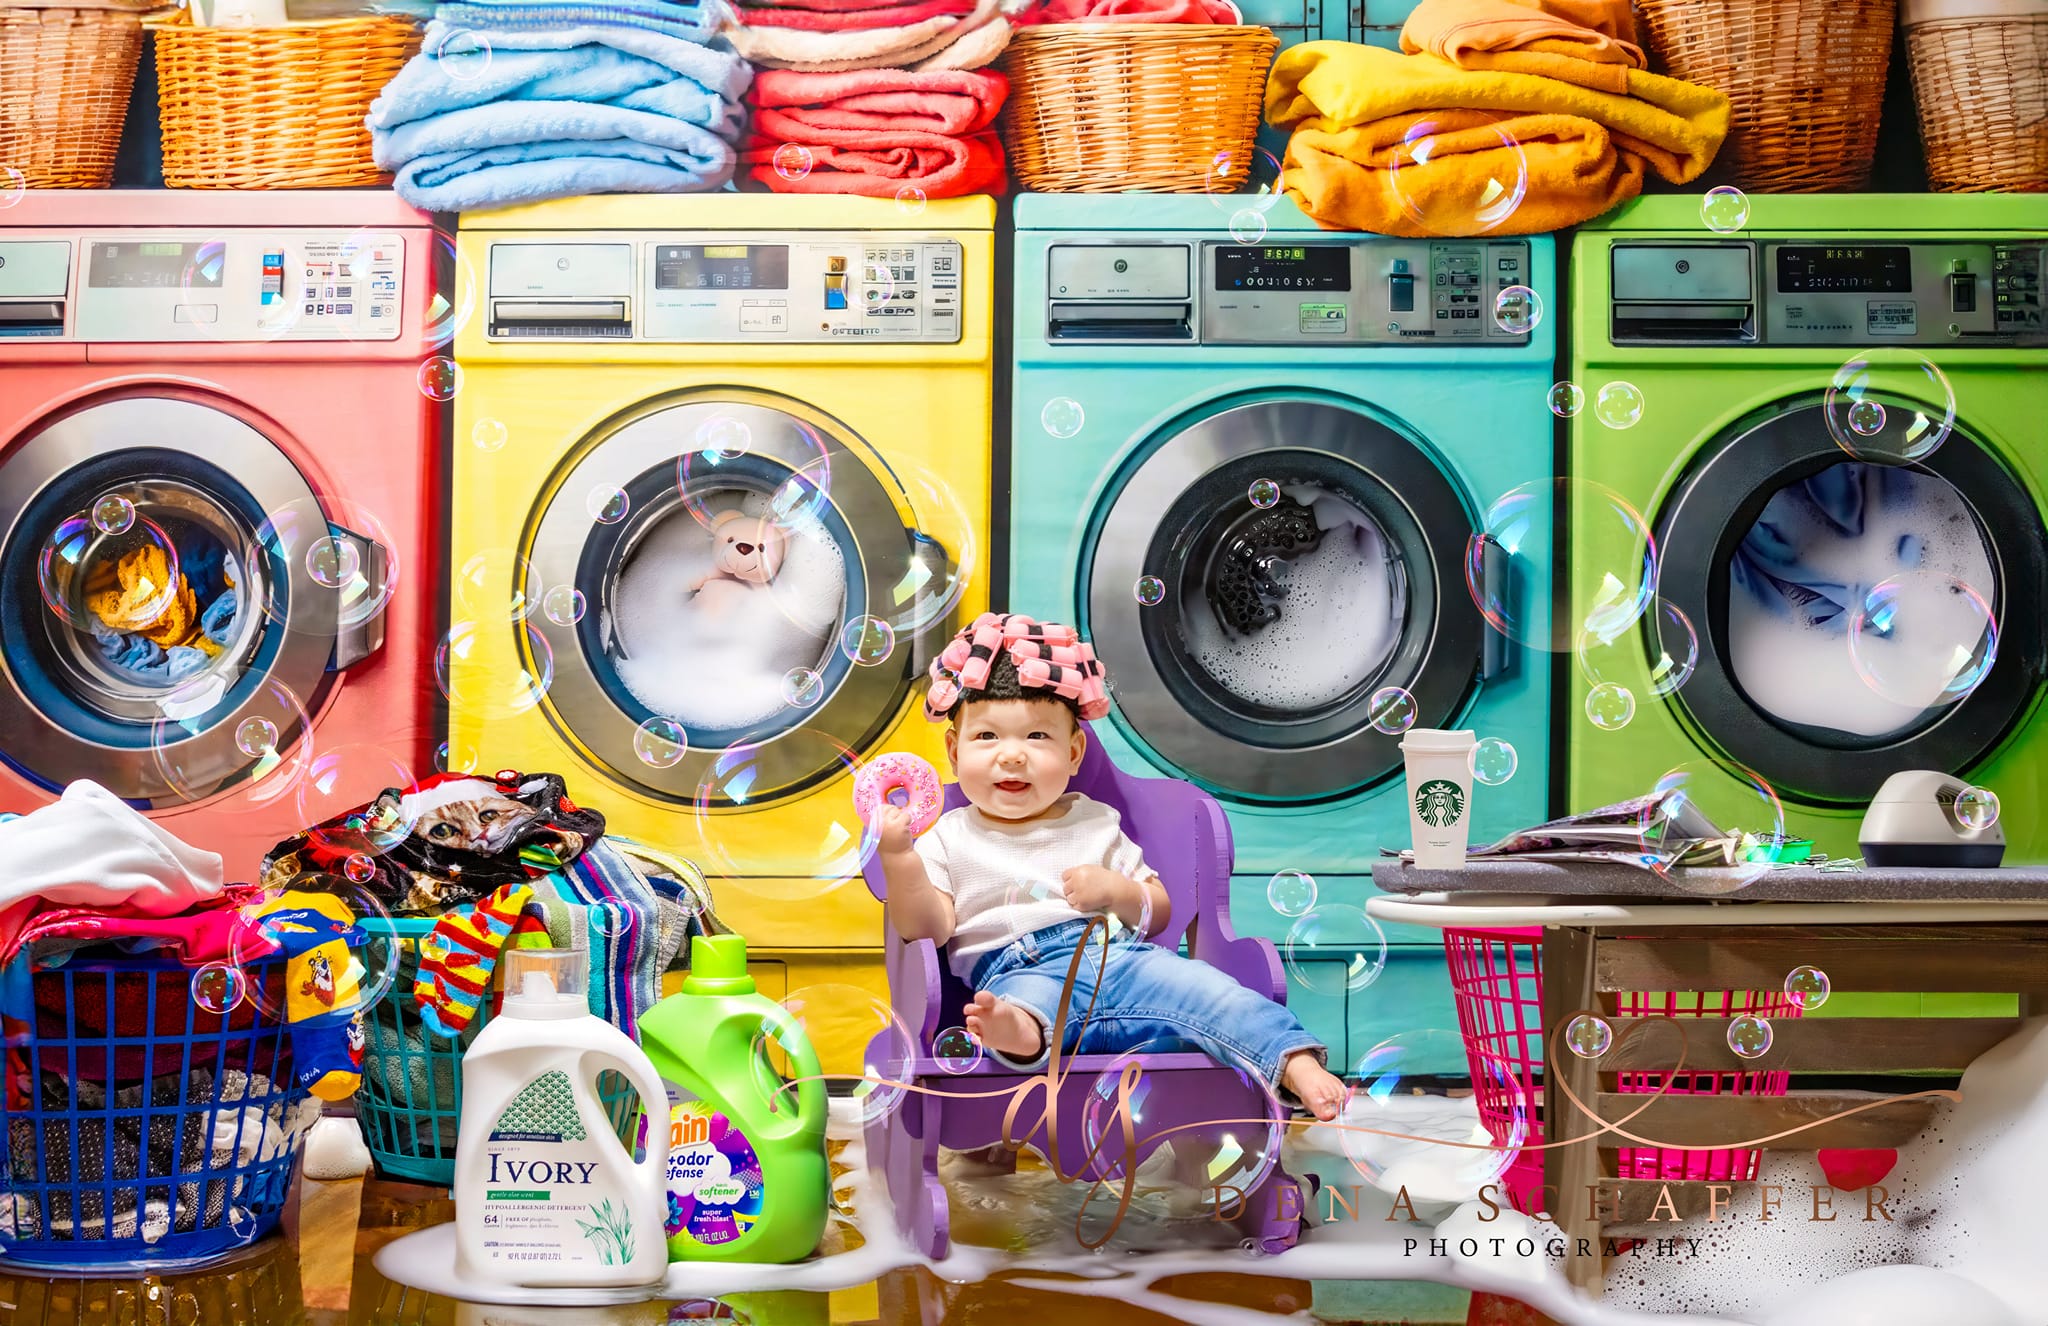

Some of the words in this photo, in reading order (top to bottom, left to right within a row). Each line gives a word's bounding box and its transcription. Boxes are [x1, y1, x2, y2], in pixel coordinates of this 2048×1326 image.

[669, 1113, 708, 1149] ain
[487, 1153, 599, 1184] IVORY
[666, 1167, 704, 1180] efense
[699, 1186, 739, 1199] softener
[484, 1214, 498, 1224] 64
[702, 1209, 722, 1217] super
